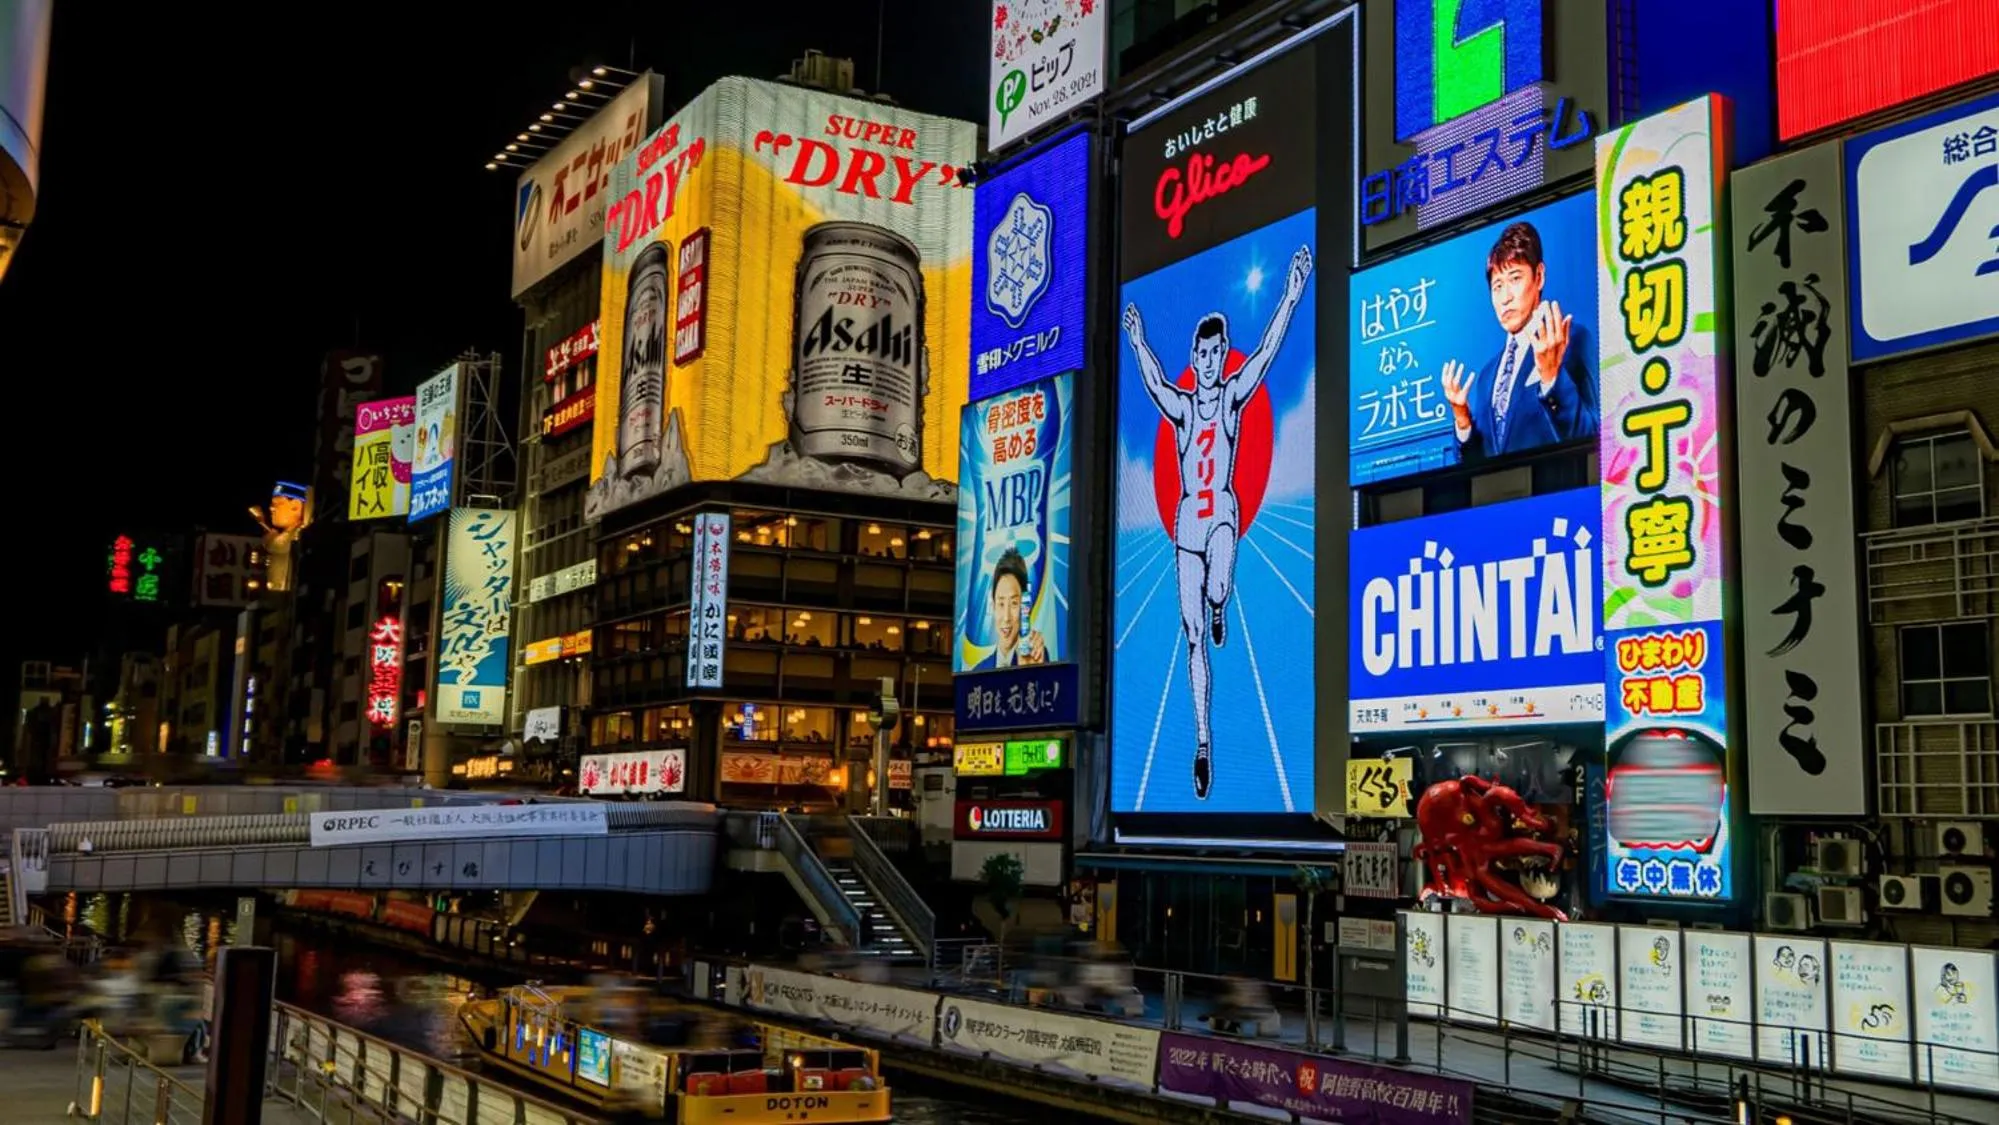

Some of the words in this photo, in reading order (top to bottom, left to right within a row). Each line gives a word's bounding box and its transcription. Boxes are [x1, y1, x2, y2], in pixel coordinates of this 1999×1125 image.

[1031, 38, 1076, 92] ピップ
[1070, 68, 1096, 96] 2021
[636, 121, 681, 178] SUPER
[824, 113, 918, 151] SUPER
[1164, 97, 1258, 158] おいしさと健康
[1361, 96, 1593, 226] 日商エステム
[1155, 152, 1270, 239] Glico
[1361, 277, 1437, 339] はやす
[803, 305, 911, 368] Asahi
[976, 326, 1061, 375] 雪印メグミルク
[842, 364, 873, 387] 生
[1619, 167, 1694, 587] 親切・丁寧
[824, 395, 889, 412] スーパードライ
[987, 394, 1044, 434] 骨密度を
[1357, 375, 1446, 434] ラボモ。
[841, 434, 869, 448] 350ml
[992, 428, 1036, 465] 高める
[370, 441, 390, 513] 高収入
[1195, 423, 1216, 519] グリコ
[1747, 178, 1832, 776] 不滅のミナミ
[986, 469, 1041, 531] MBP
[1362, 518, 1594, 677] CHINTAI
[703, 602, 721, 681] かに道楽
[1617, 630, 1706, 672] ひまわり
[1356, 708, 1389, 724] 天気予報
[1622, 674, 1704, 714] 不動産
[983, 808, 1044, 829] LOTTERIA
[1617, 858, 1722, 896] 年中無休
[767, 1096, 829, 1111] DOTON
[1169, 1048, 1208, 1071] 2022年
[1212, 1056, 1293, 1086] 新たな時代へ
[1299, 1066, 1316, 1092] 祝
[1320, 1073, 1444, 1115] 阿倍野高校百周年
